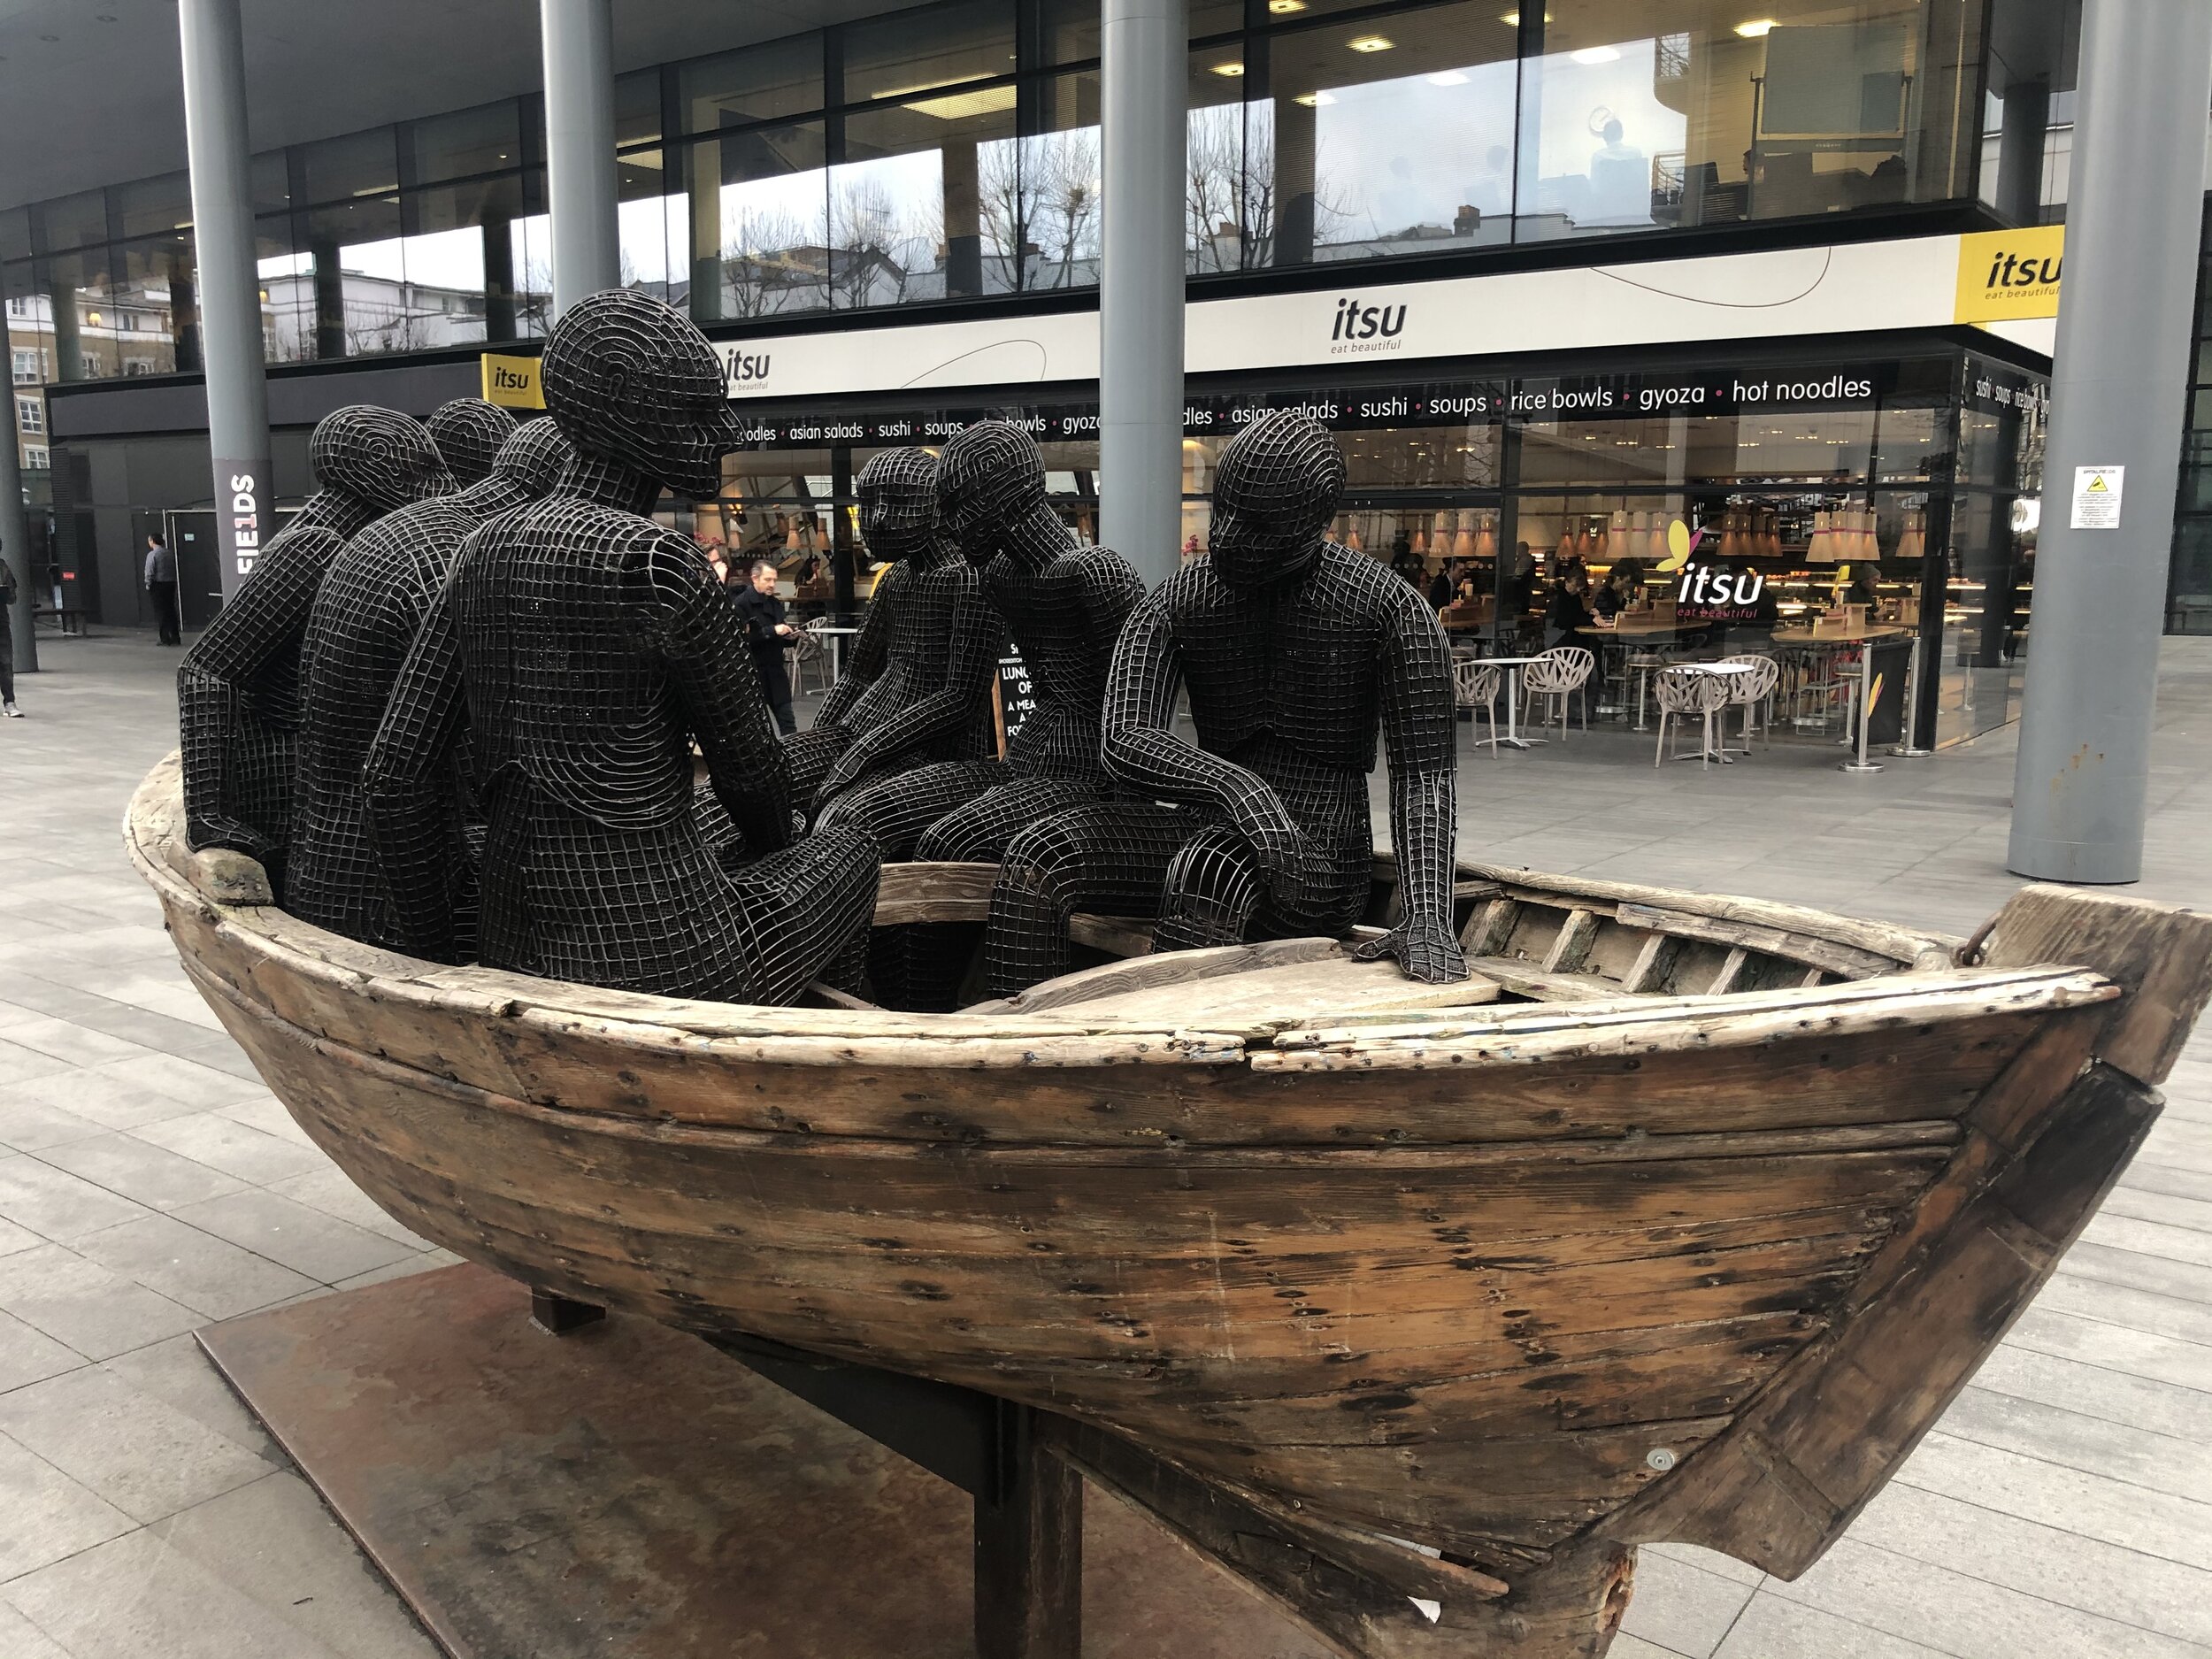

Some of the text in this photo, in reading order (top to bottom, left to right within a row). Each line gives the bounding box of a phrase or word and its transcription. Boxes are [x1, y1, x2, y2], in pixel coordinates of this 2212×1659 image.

[1986, 251, 2062, 288] itsu
[1985, 286, 2060, 300] eat beautiful
[1332, 297, 1408, 341] itsu
[1331, 339, 1402, 354] eat beautiful
[726, 348, 771, 381] itsu
[495, 366, 529, 389] itsu
[738, 381, 769, 391] beautiful
[1976, 375, 1992, 399] sushi
[1994, 385, 2011, 409] soups
[789, 425, 821, 440] asian
[824, 421, 864, 439] salads
[879, 419, 910, 437] sushi
[925, 421, 964, 439] soups
[1182, 406, 1213, 426] dles
[1360, 396, 1408, 418] sushi
[1429, 396, 1487, 418] soups
[1510, 390, 1547, 411] rice
[1552, 386, 1613, 409] bowls
[1640, 387, 1705, 411] gyoza
[1733, 380, 1769, 402] hot
[1776, 374, 1871, 401] noodles
[1678, 562, 1763, 605] itsu
[1677, 607, 1758, 618] eat beautiful
[1002, 666, 1029, 680] LUNC
[1008, 699, 1036, 711] A MEA
[1019, 712, 1026, 723] A
